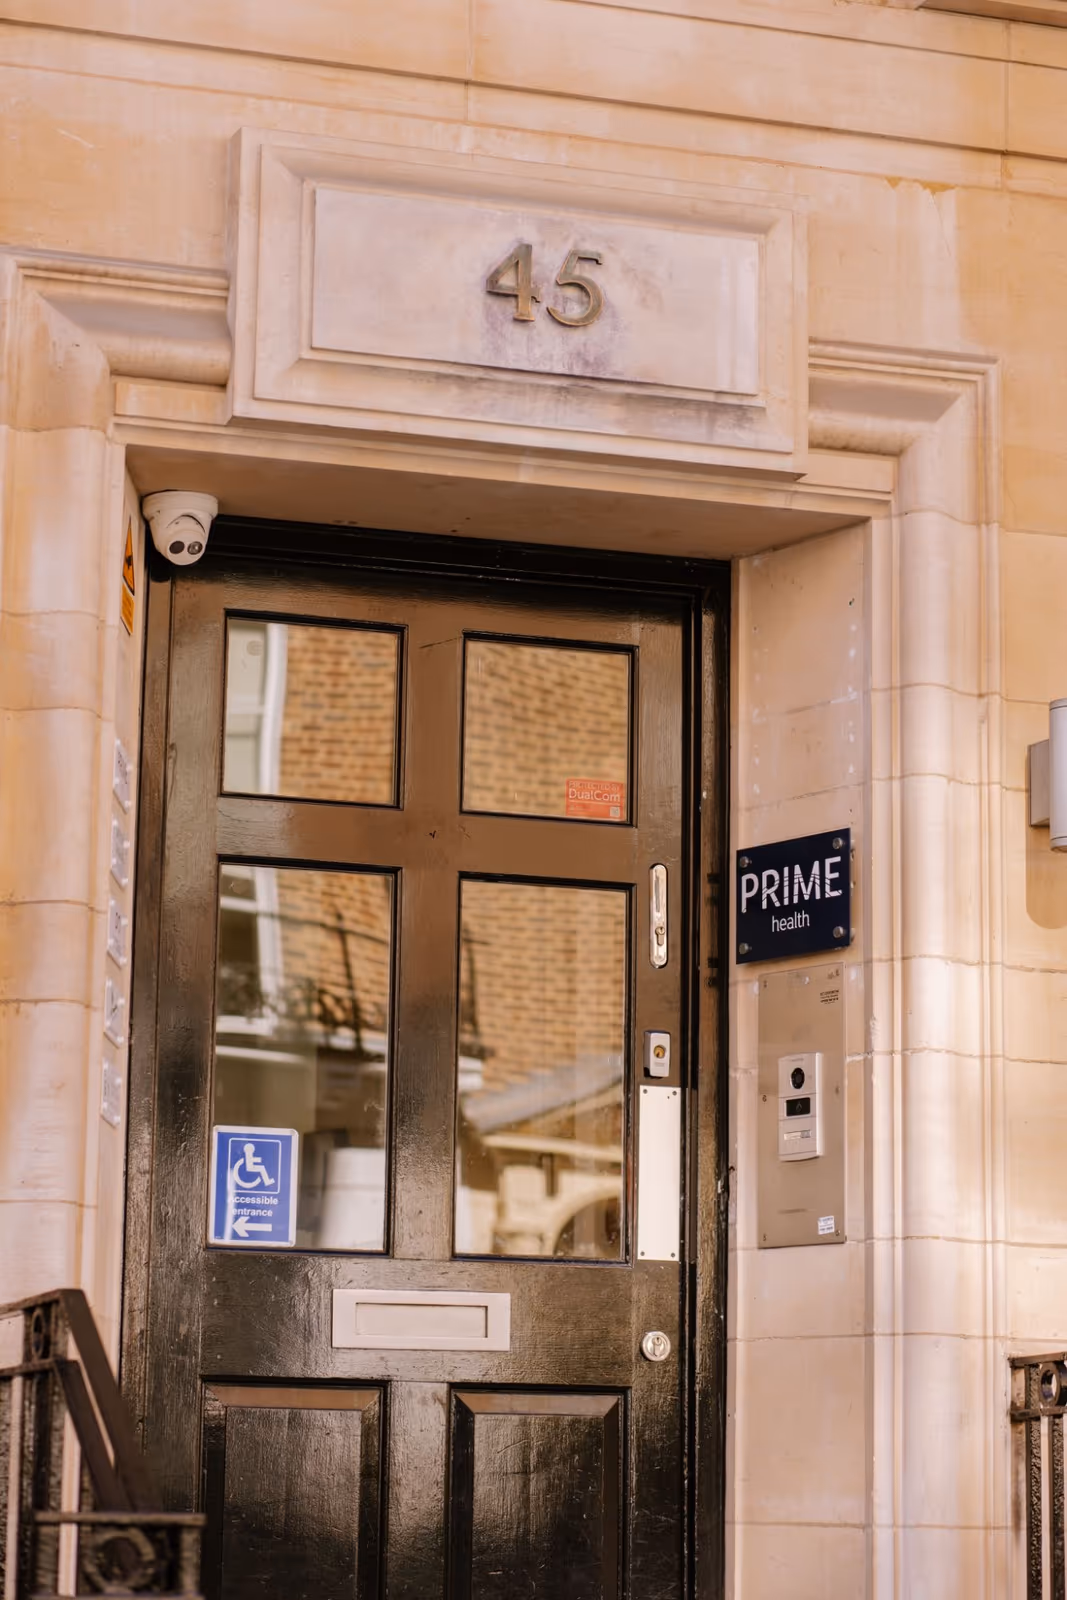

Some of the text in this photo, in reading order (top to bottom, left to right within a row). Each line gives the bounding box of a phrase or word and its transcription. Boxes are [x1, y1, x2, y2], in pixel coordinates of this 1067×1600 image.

[486, 243, 604, 327] 45
[569, 788, 620, 801] DualCom
[741, 856, 842, 913] PRIME
[771, 910, 809, 932] health
[232, 1207, 273, 1217] entrance
